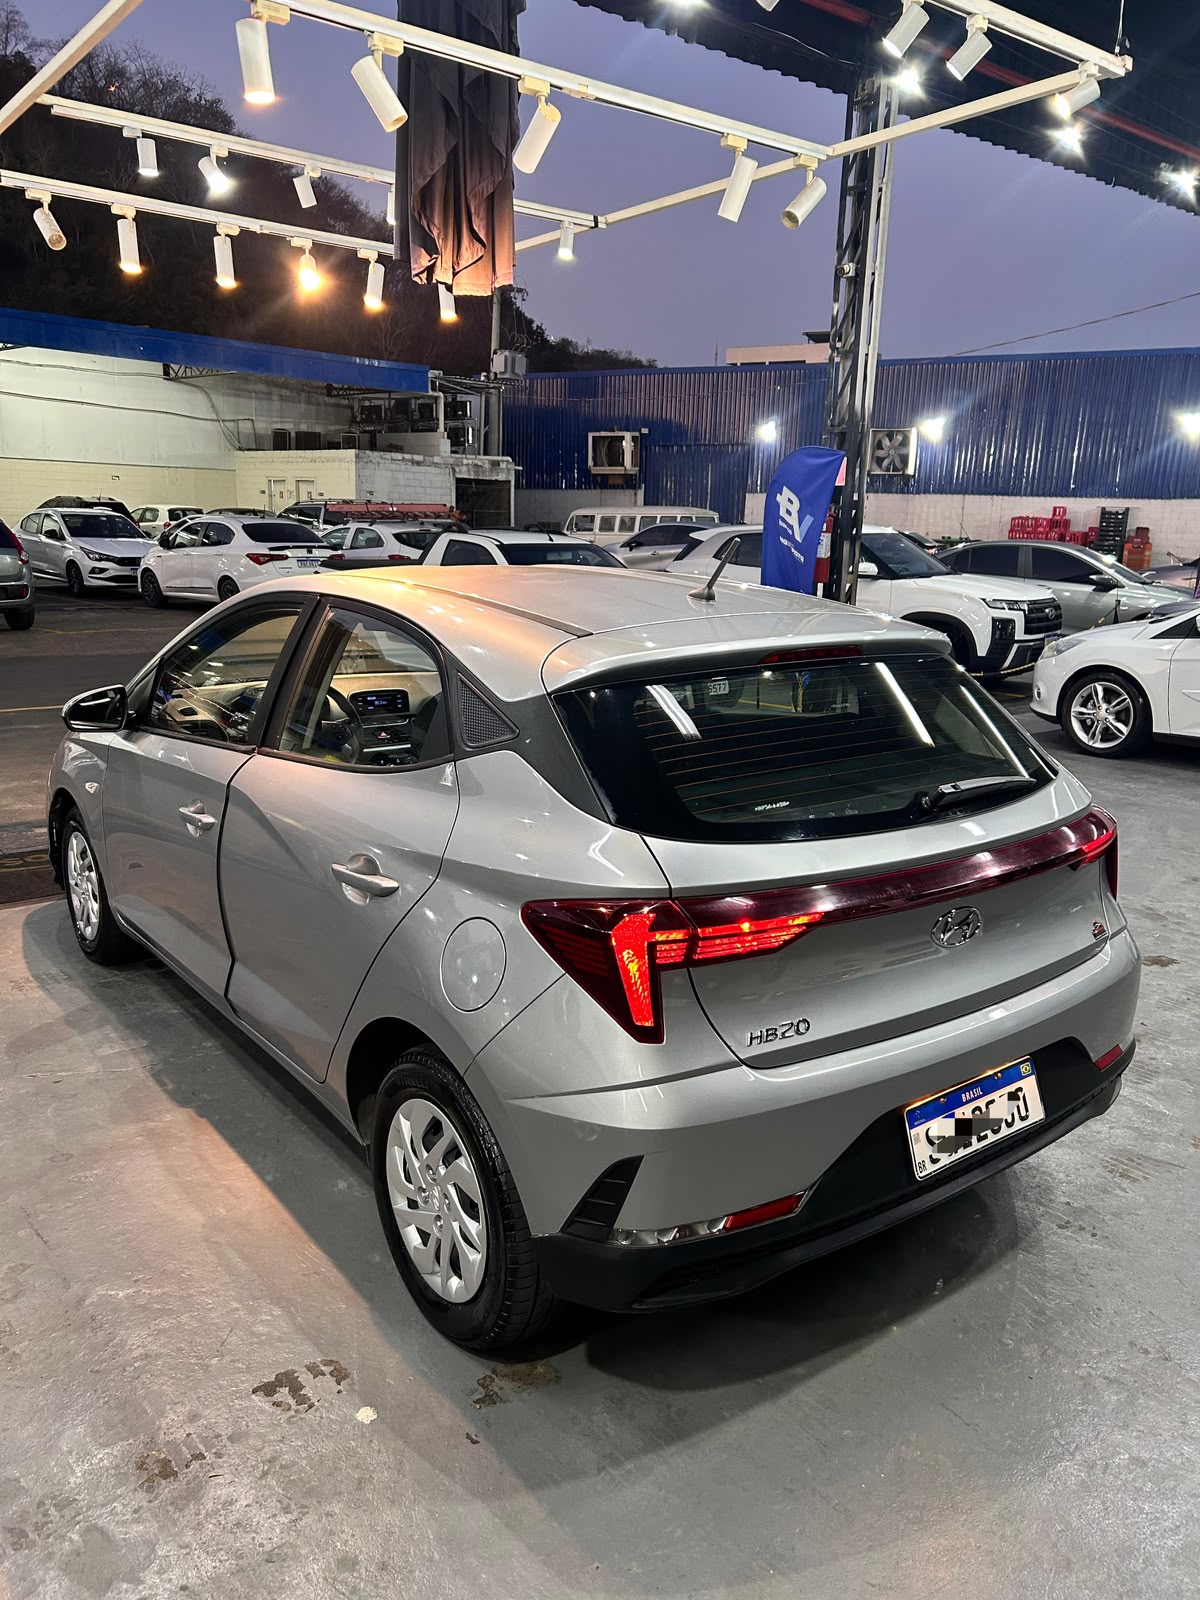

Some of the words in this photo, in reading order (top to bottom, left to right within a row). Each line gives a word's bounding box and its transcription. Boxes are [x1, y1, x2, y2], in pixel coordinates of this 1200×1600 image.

[746, 1017, 811, 1048] HB20
[961, 1087, 983, 1102] BRASIL
[917, 1160, 928, 1174] BR
